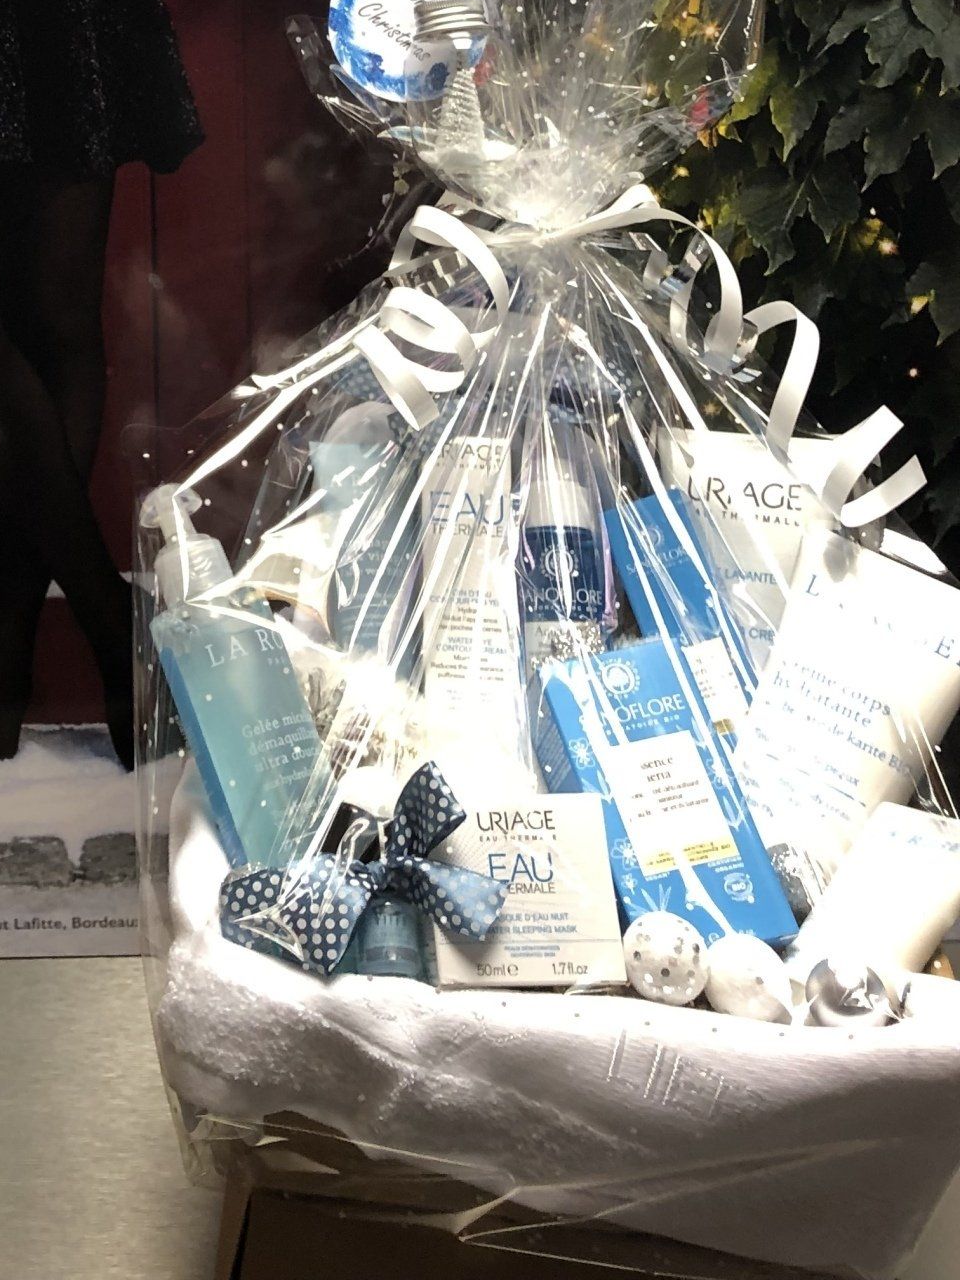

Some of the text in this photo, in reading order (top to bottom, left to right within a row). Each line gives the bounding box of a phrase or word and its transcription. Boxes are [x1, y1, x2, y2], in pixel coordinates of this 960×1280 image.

[204, 635, 249, 668] LA
[476, 810, 556, 835] URIAGE
[488, 851, 554, 883] EAU
[13, 917, 67, 932] Lafitte,
